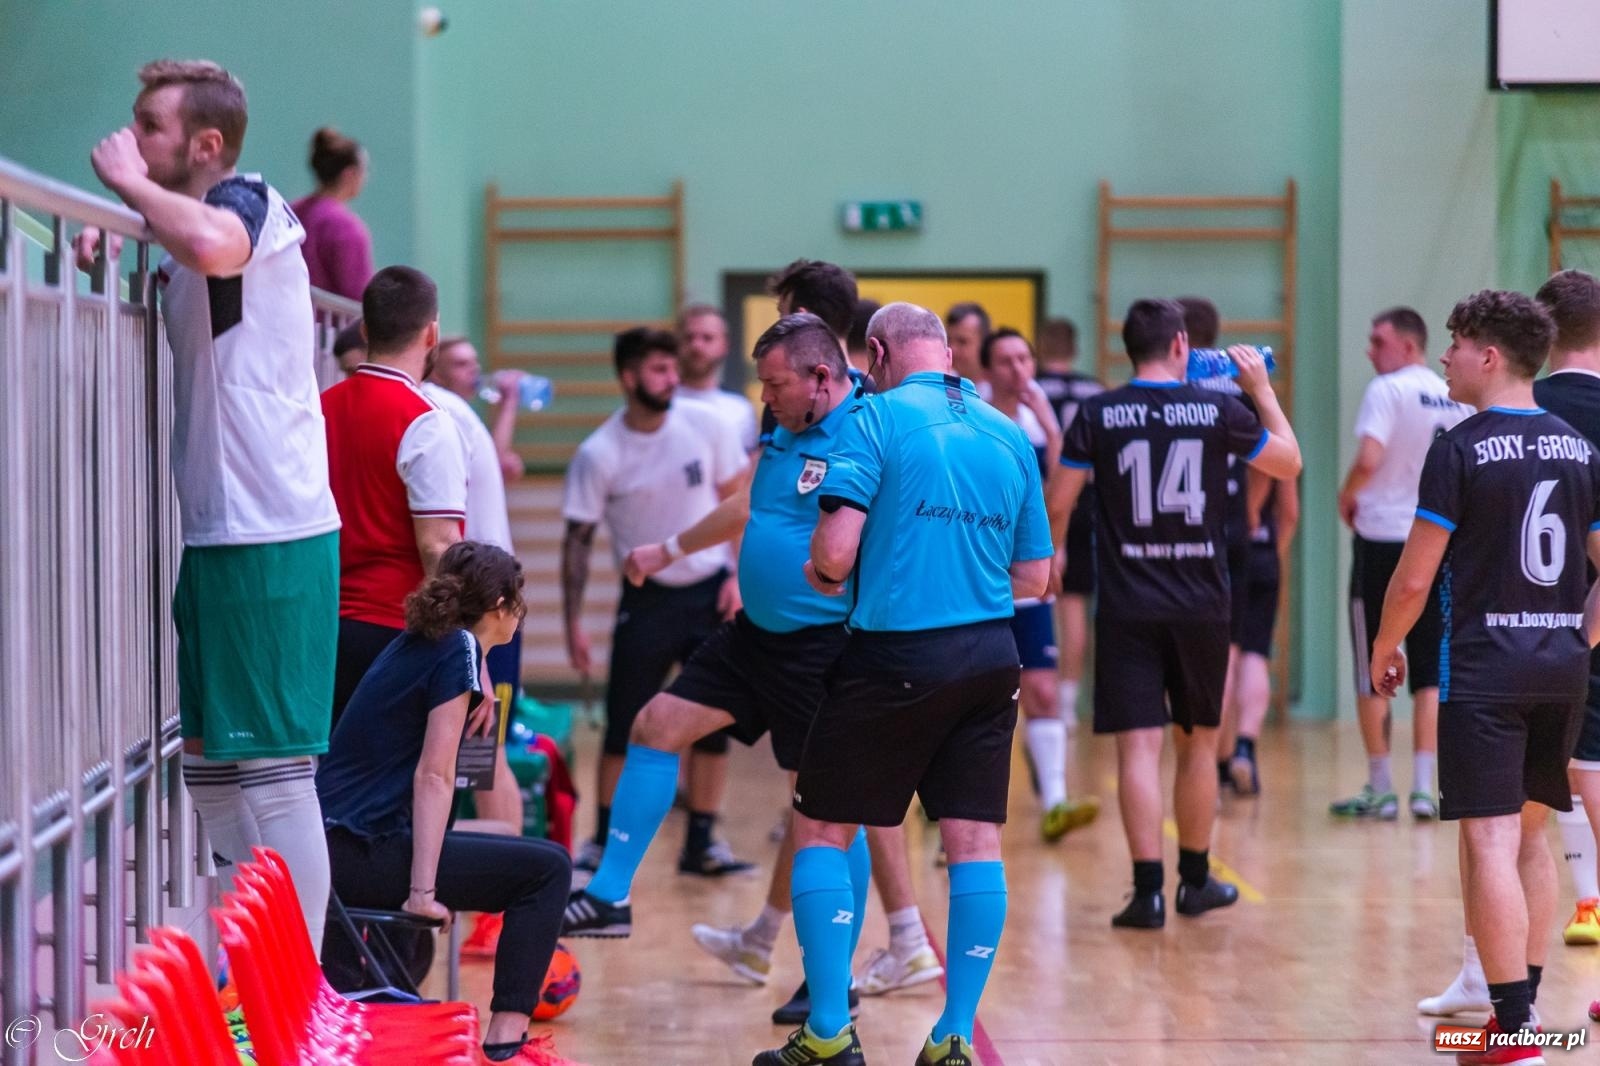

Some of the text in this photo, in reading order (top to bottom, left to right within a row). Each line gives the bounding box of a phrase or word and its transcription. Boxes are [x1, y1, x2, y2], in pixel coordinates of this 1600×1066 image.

[1102, 403, 1147, 429] BOXY
[1163, 402, 1219, 427] GROUP
[1473, 434, 1524, 465] BOXY
[1117, 438, 1206, 527] 14
[1520, 479, 1567, 587] 6
